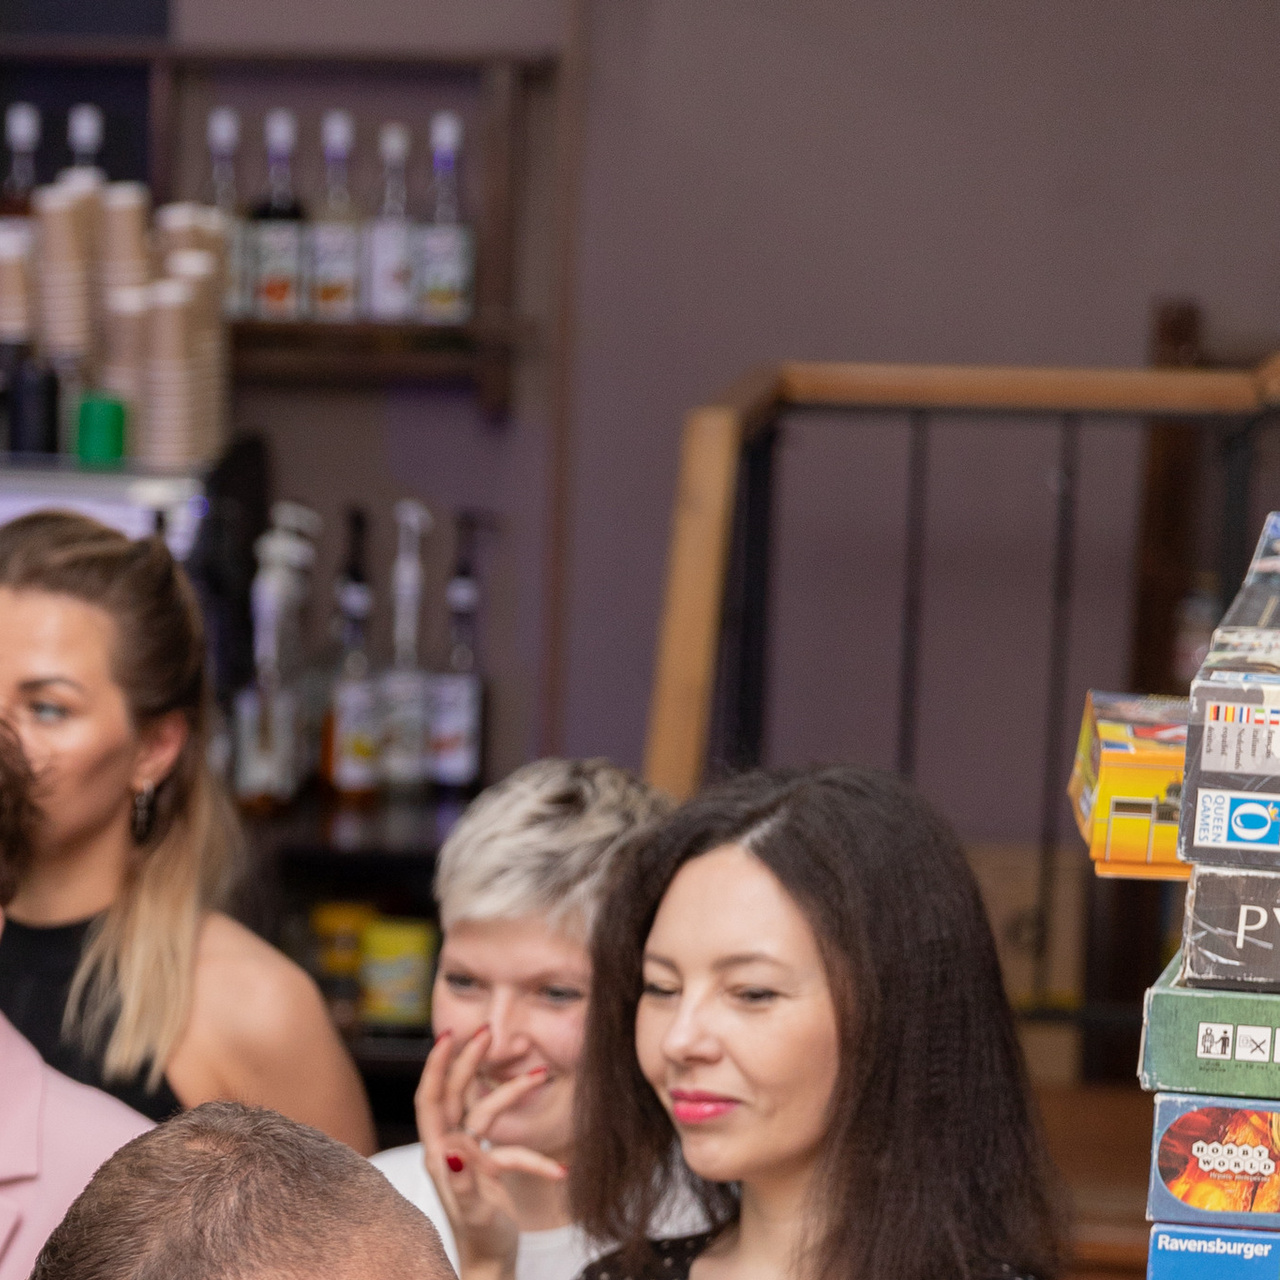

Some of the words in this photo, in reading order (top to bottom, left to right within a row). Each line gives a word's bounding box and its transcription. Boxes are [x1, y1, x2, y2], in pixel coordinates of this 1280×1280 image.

[1199, 795, 1212, 842] GAMES
[1212, 795, 1226, 843] QUEEN
[1157, 1234, 1272, 1259] Ravensburger
